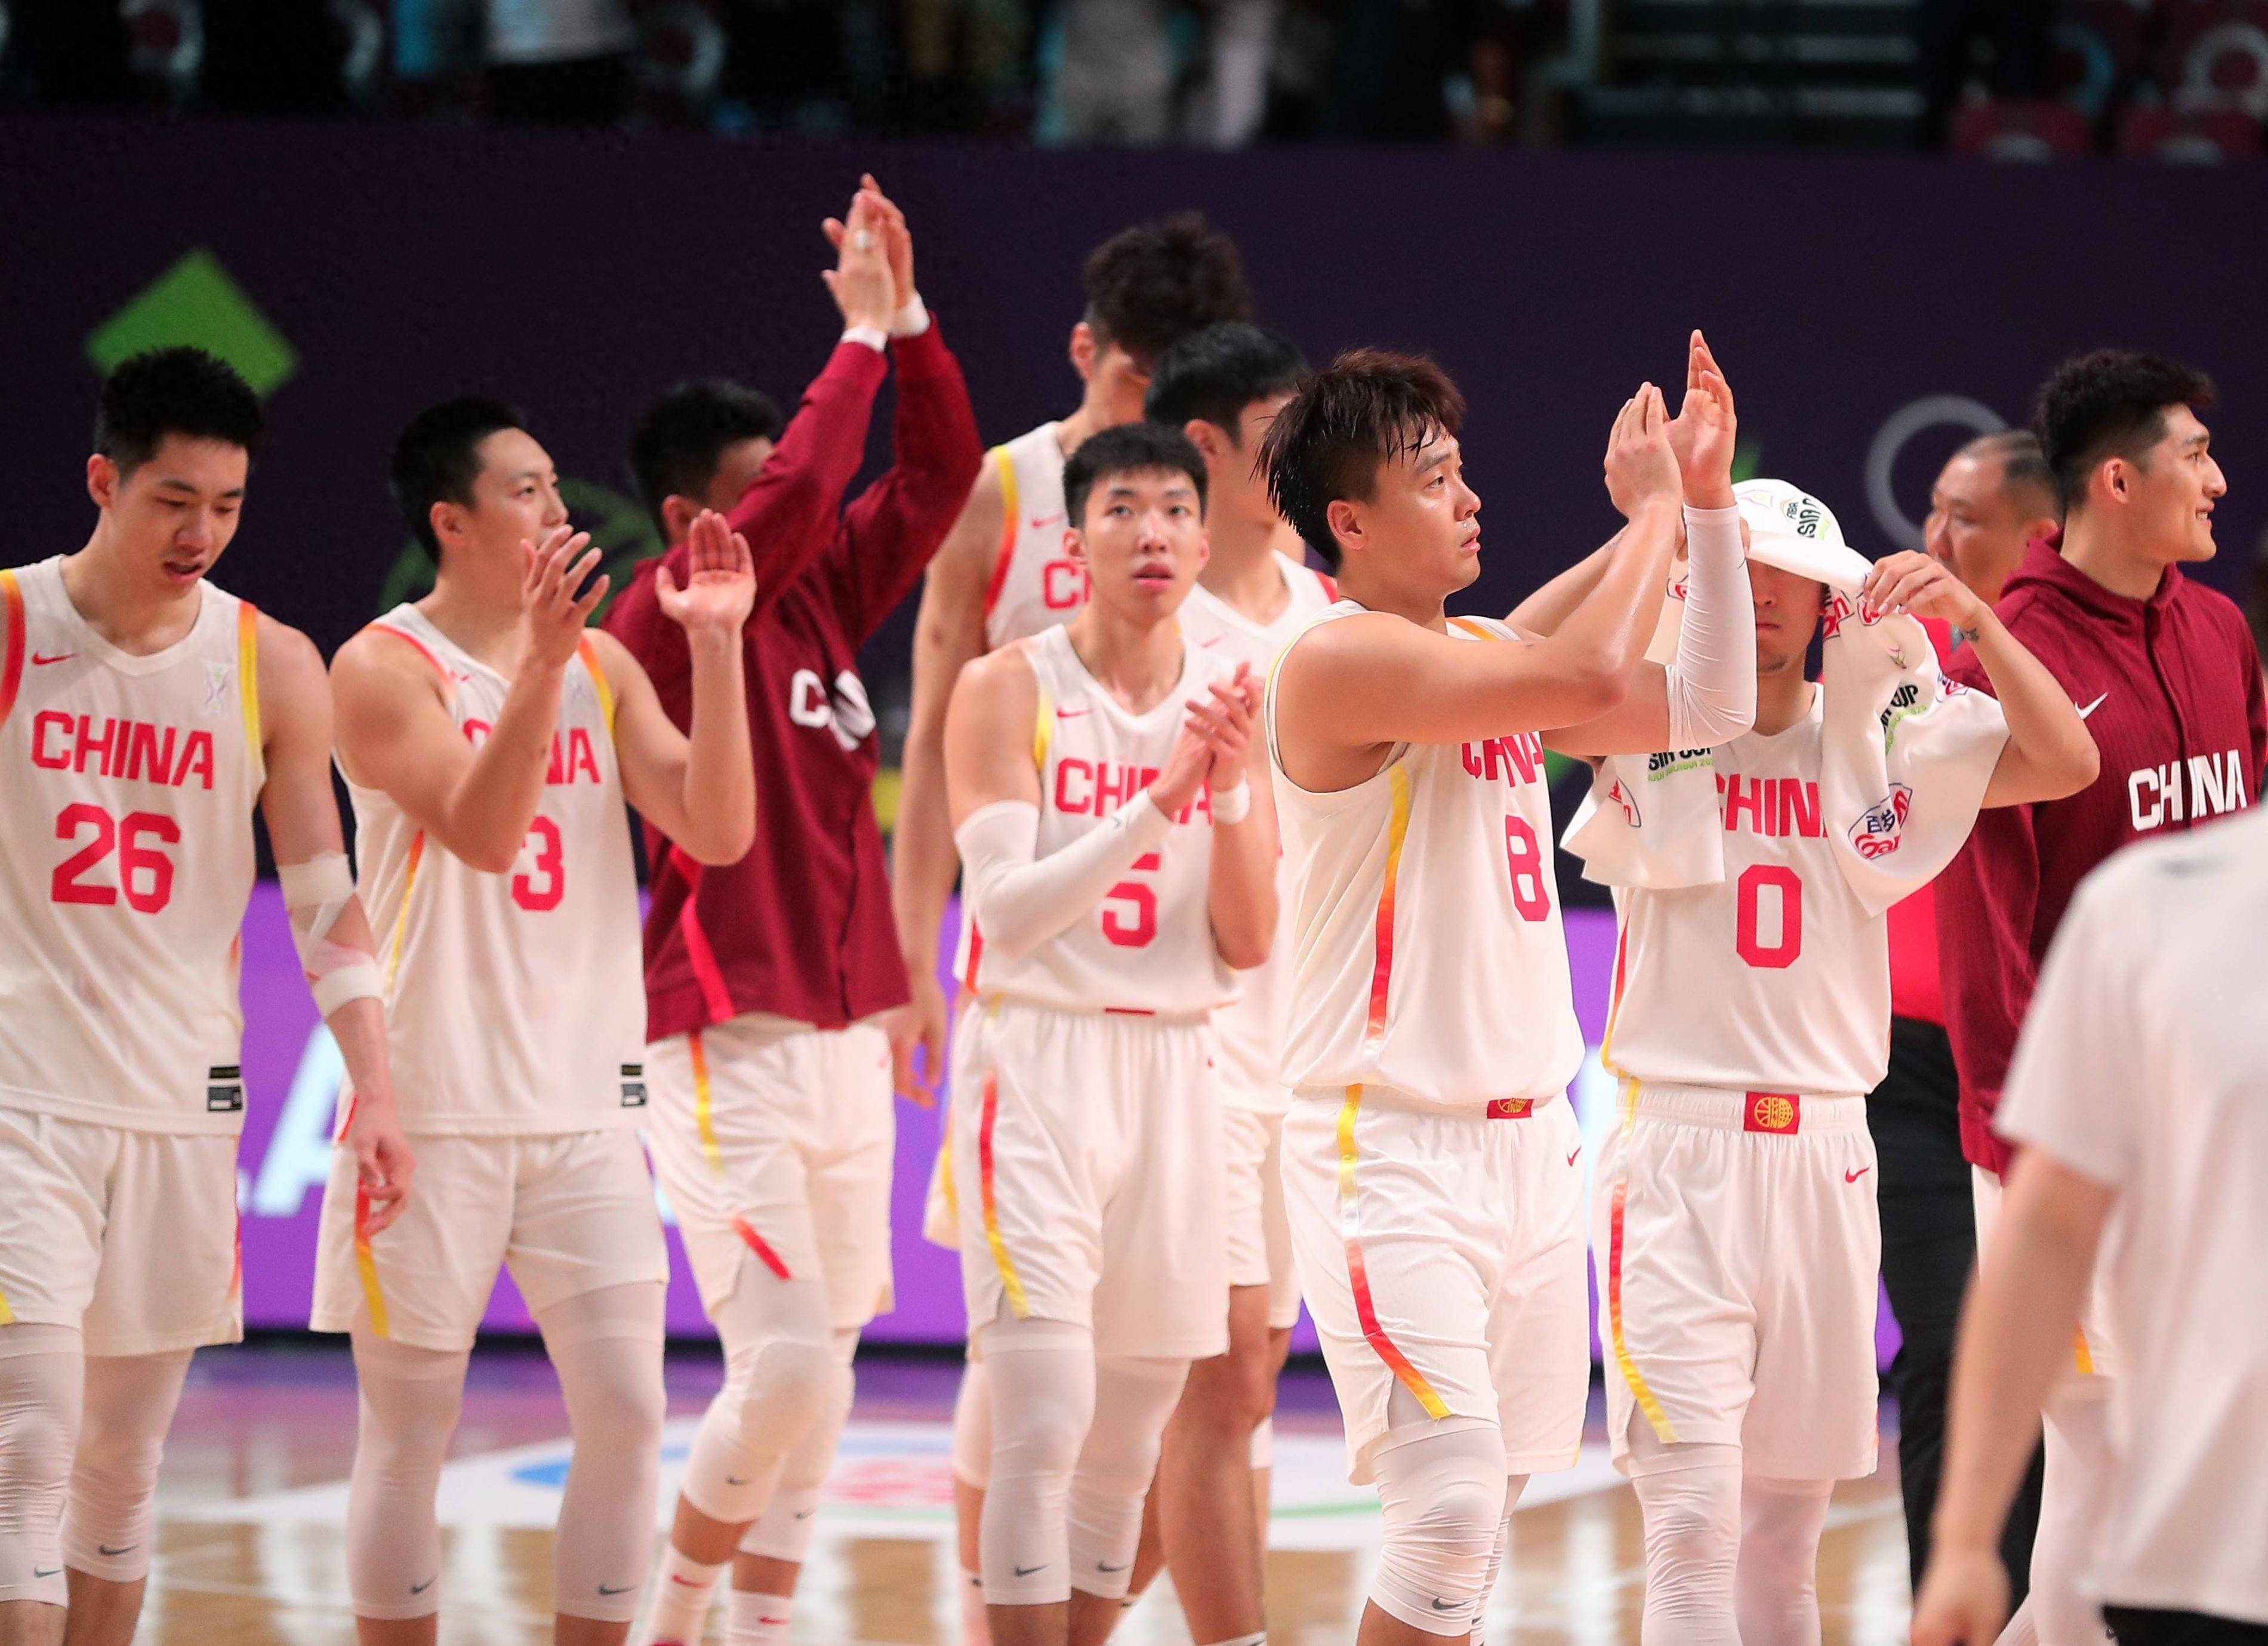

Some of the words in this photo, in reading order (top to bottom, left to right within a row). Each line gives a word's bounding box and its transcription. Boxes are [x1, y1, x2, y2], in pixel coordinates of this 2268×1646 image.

[32, 710, 213, 790] CHINA
[2128, 749, 2248, 832] CHINA
[1715, 773, 1828, 838] HIN
[51, 803, 180, 914] 26
[511, 815, 564, 911] 3
[1102, 853, 1161, 948] 5
[1505, 814, 1551, 921] 8
[1737, 864, 1802, 968] 0
